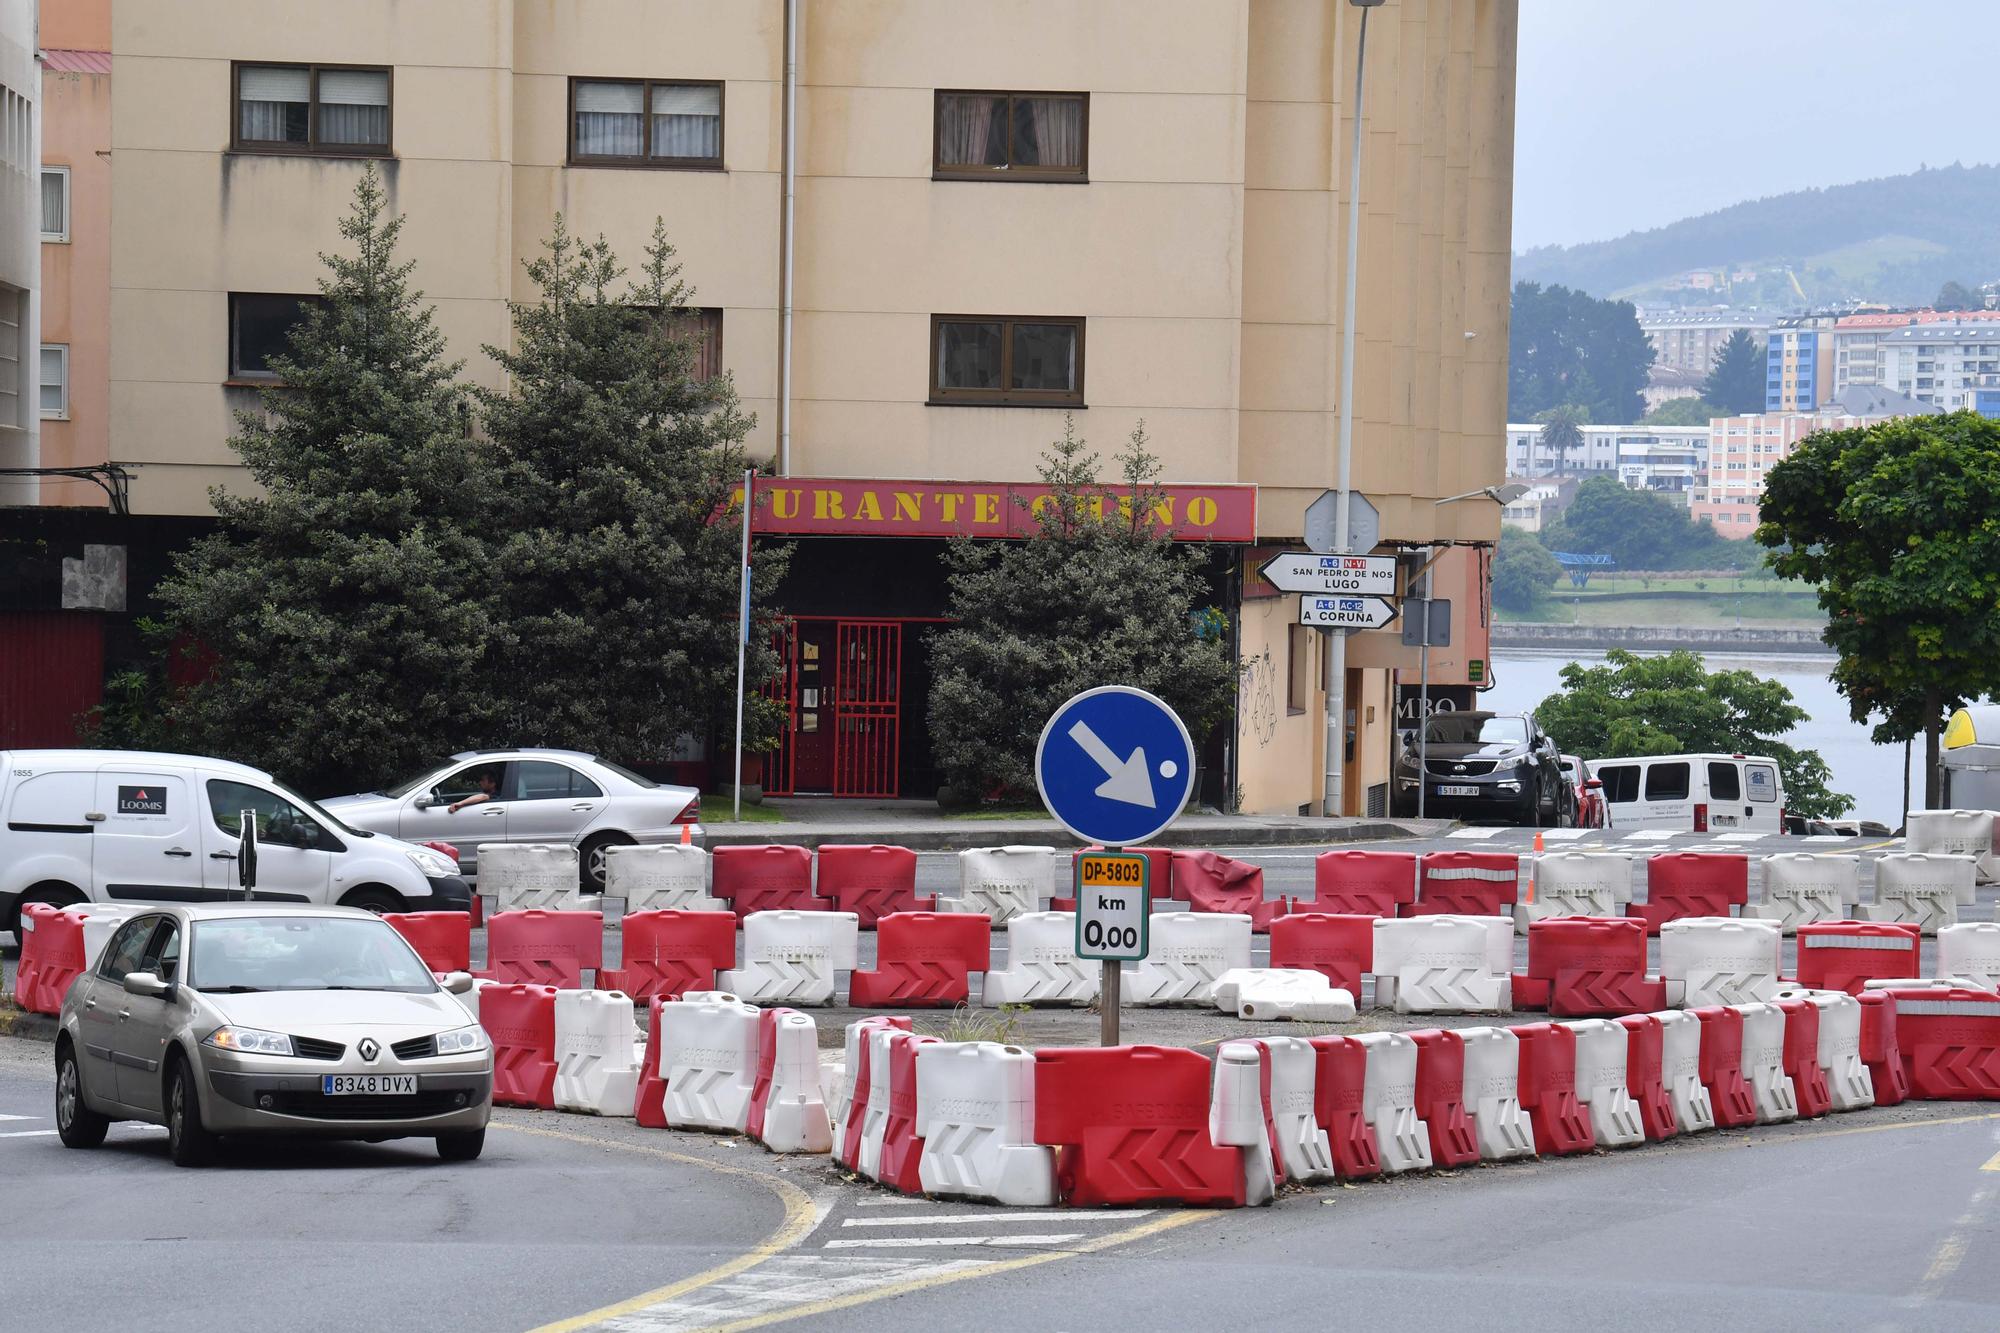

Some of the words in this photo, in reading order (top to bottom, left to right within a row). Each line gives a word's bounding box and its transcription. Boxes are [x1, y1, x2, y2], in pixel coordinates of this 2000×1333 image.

[1293, 568, 1312, 576] SAN
[1318, 569, 1349, 577] PEDRO
[1325, 579, 1359, 589] LUGO
[1340, 602, 1363, 610] AC-12
[1304, 611, 1311, 620] A
[13, 769, 32, 777] 1855
[121, 799, 162, 810] LOOMIS
[1085, 862, 1140, 882] DP-5803
[1098, 895, 1125, 910] km
[1084, 920, 1137, 950] 0,00
[334, 1077, 376, 1092] 8348
[382, 1077, 412, 1092] DVX
